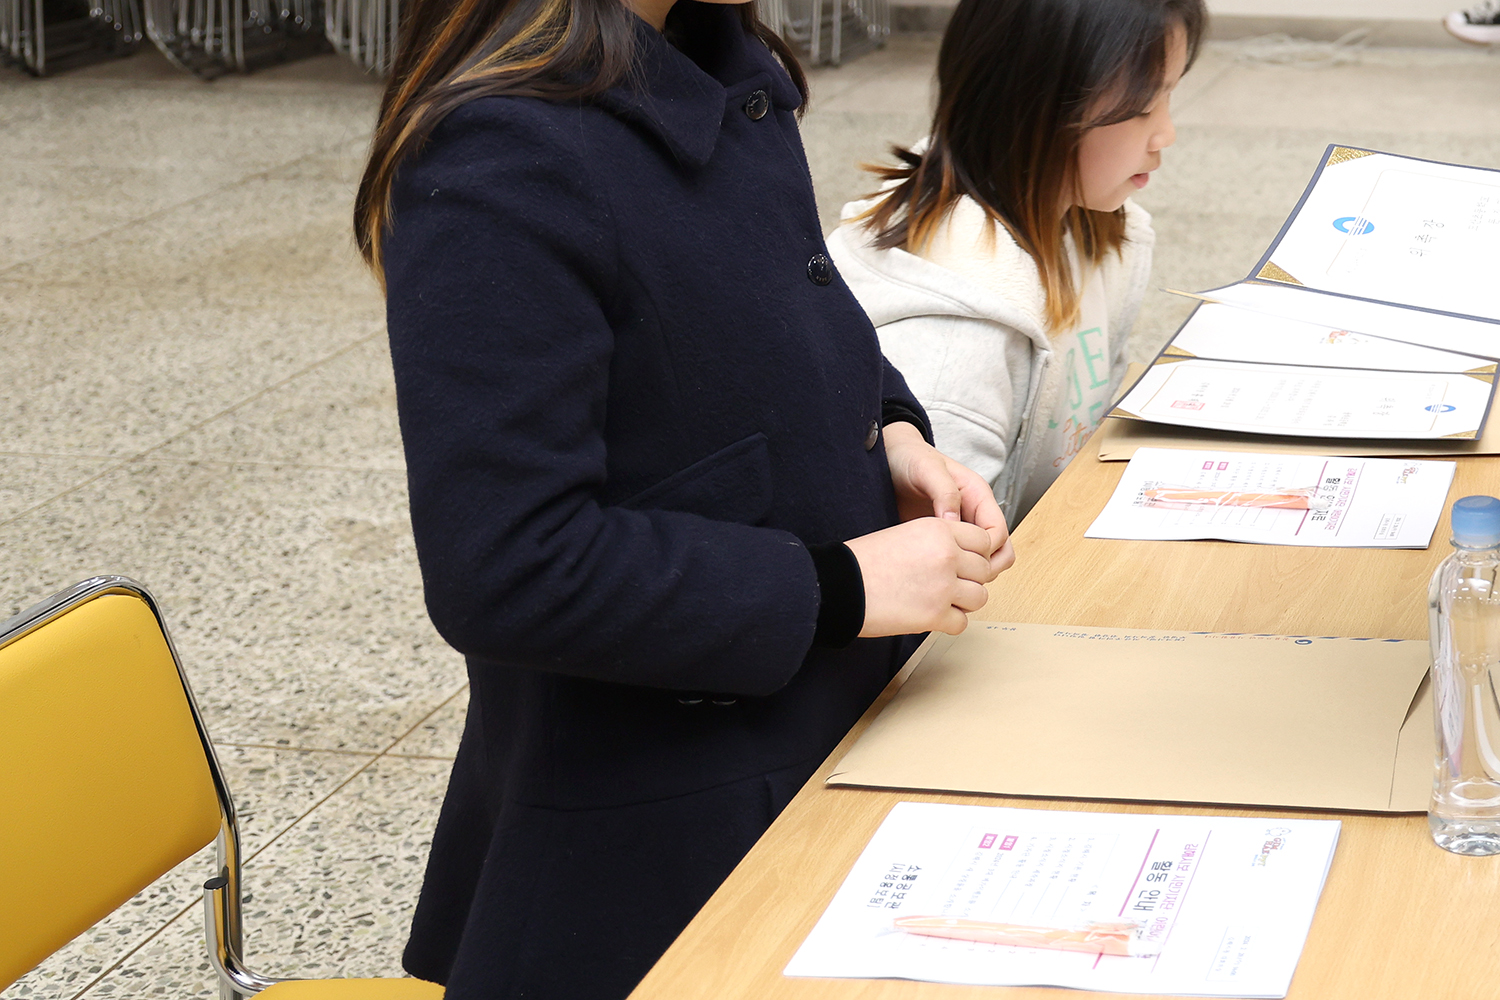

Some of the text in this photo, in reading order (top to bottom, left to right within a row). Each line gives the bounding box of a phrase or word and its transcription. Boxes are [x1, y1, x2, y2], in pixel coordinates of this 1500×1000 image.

[1177, 844, 1198, 871] 김해시보
[1146, 861, 1172, 882] 활동
[884, 865, 921, 909] 소통공보관
[1133, 890, 1160, 911] 안내
[1159, 875, 1185, 910] 시민기자단
